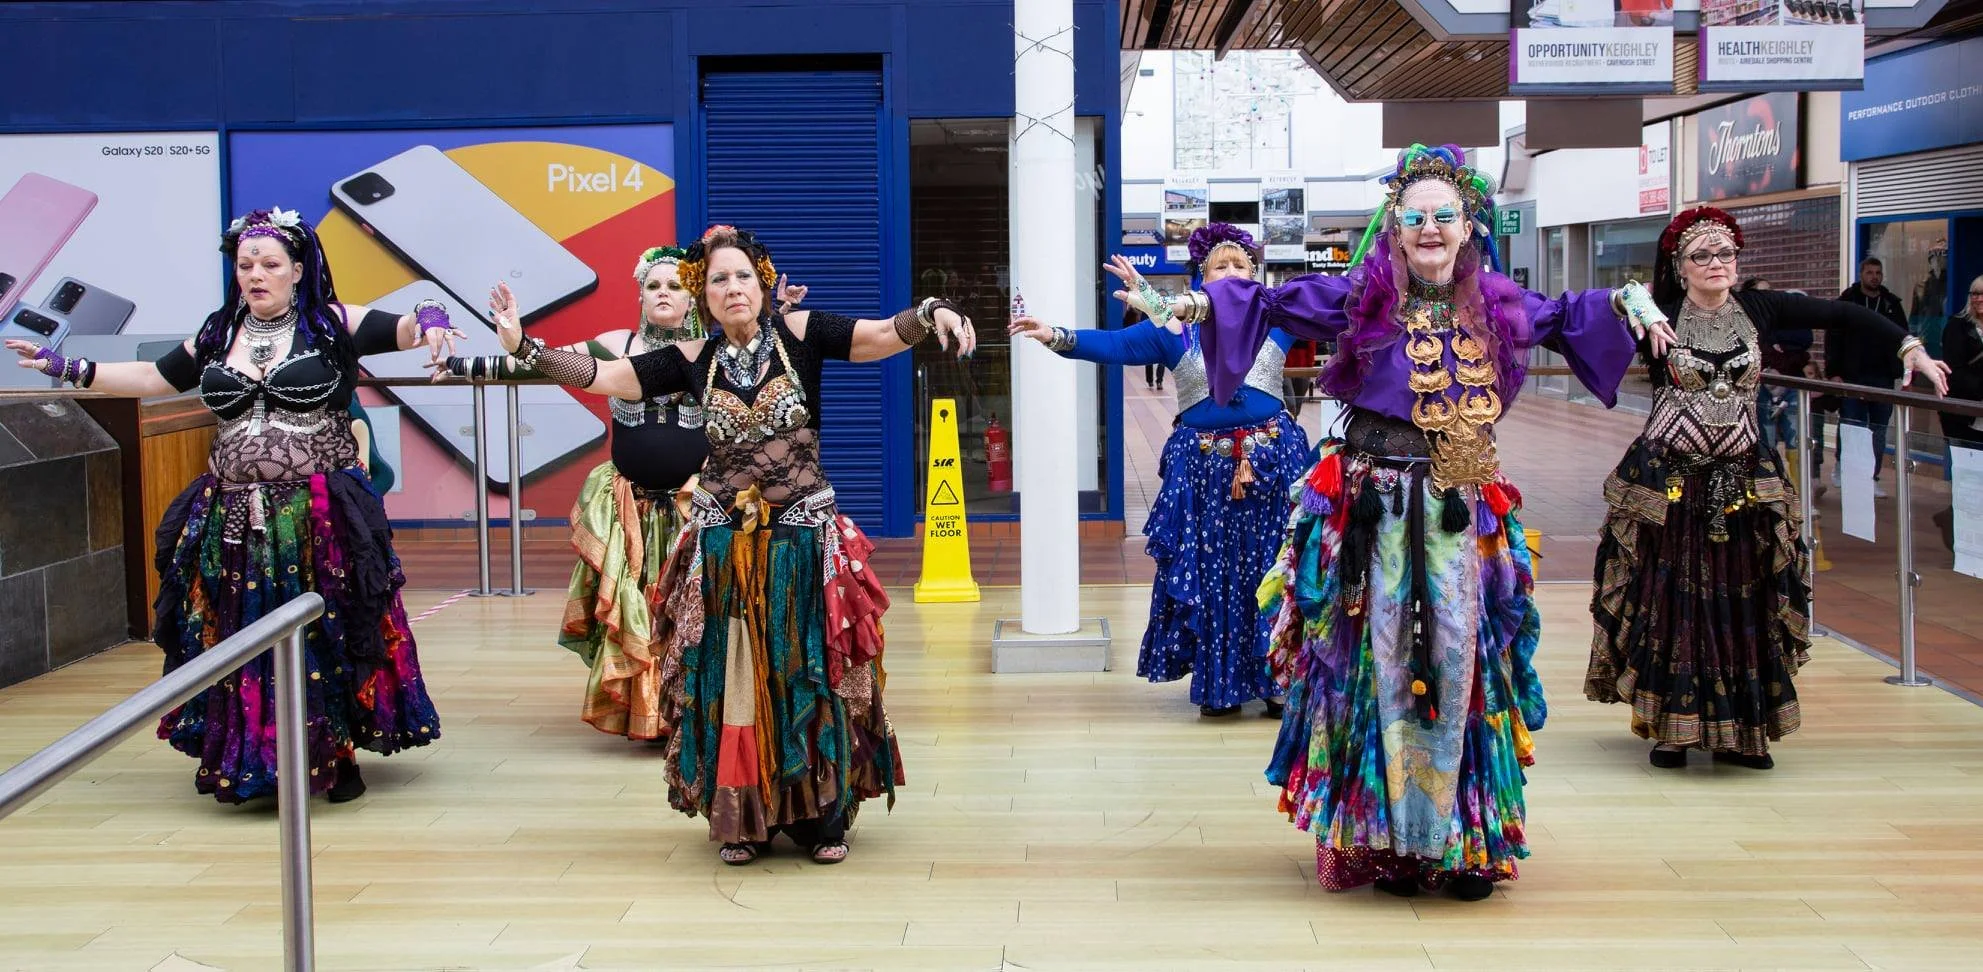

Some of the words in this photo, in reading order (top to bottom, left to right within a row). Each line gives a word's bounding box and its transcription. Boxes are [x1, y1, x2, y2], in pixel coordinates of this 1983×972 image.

[1739, 57, 1765, 65] AIREDALE
[1766, 56, 1793, 64] SHOPPING
[1794, 56, 1813, 64] CENTRE
[1848, 101, 1904, 120] PERFORMANCE
[1905, 91, 1947, 110] OUTDOOR
[102, 146, 142, 158] Galaxy
[144, 146, 164, 156] S20
[195, 145, 211, 155] 5G
[1649, 149, 1656, 164] TO
[1657, 146, 1668, 163] LET
[1709, 120, 1781, 175] Thorntons
[548, 162, 616, 192] Pixel
[622, 161, 644, 192] 4
[936, 521, 956, 529] WET
[931, 530, 962, 538] FLOOR
